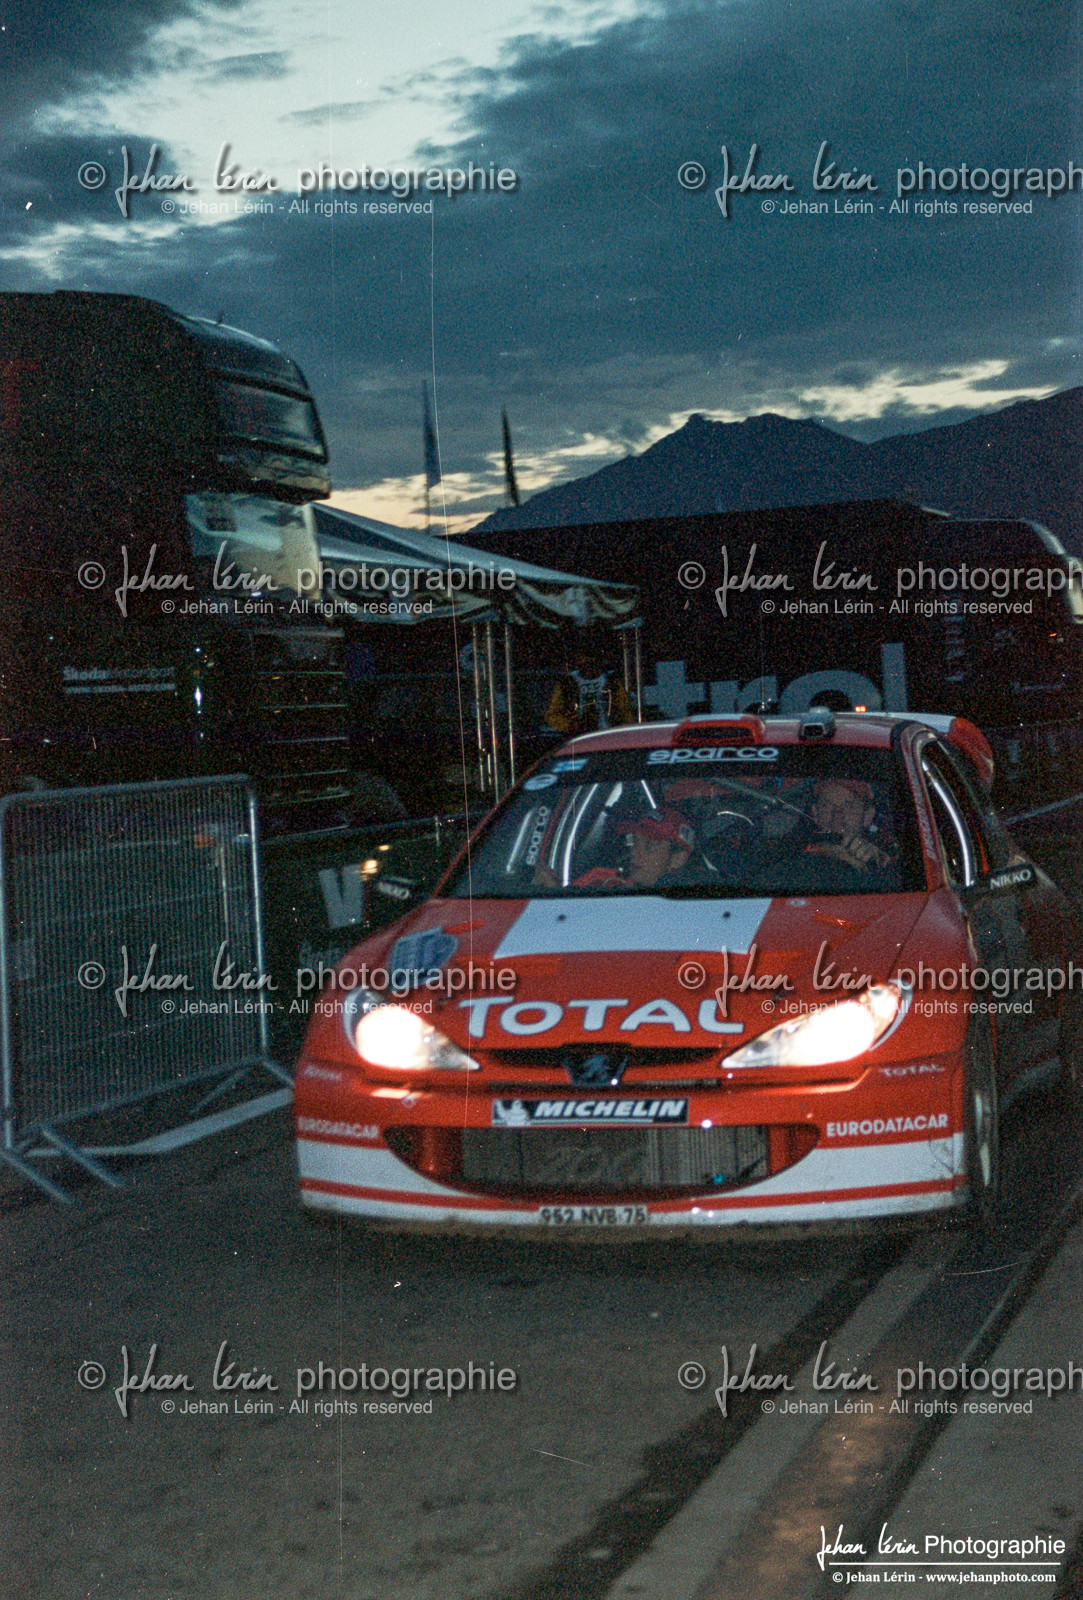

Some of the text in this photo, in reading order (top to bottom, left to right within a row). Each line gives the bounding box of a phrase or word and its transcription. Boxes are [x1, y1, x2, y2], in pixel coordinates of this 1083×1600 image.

[646, 745, 779, 763] sparco
[990, 868, 1033, 890] NIKKO
[458, 995, 745, 1039] TOTAL
[534, 1099, 686, 1118] MICHELIN
[826, 1113, 949, 1138] EURODATACAR
